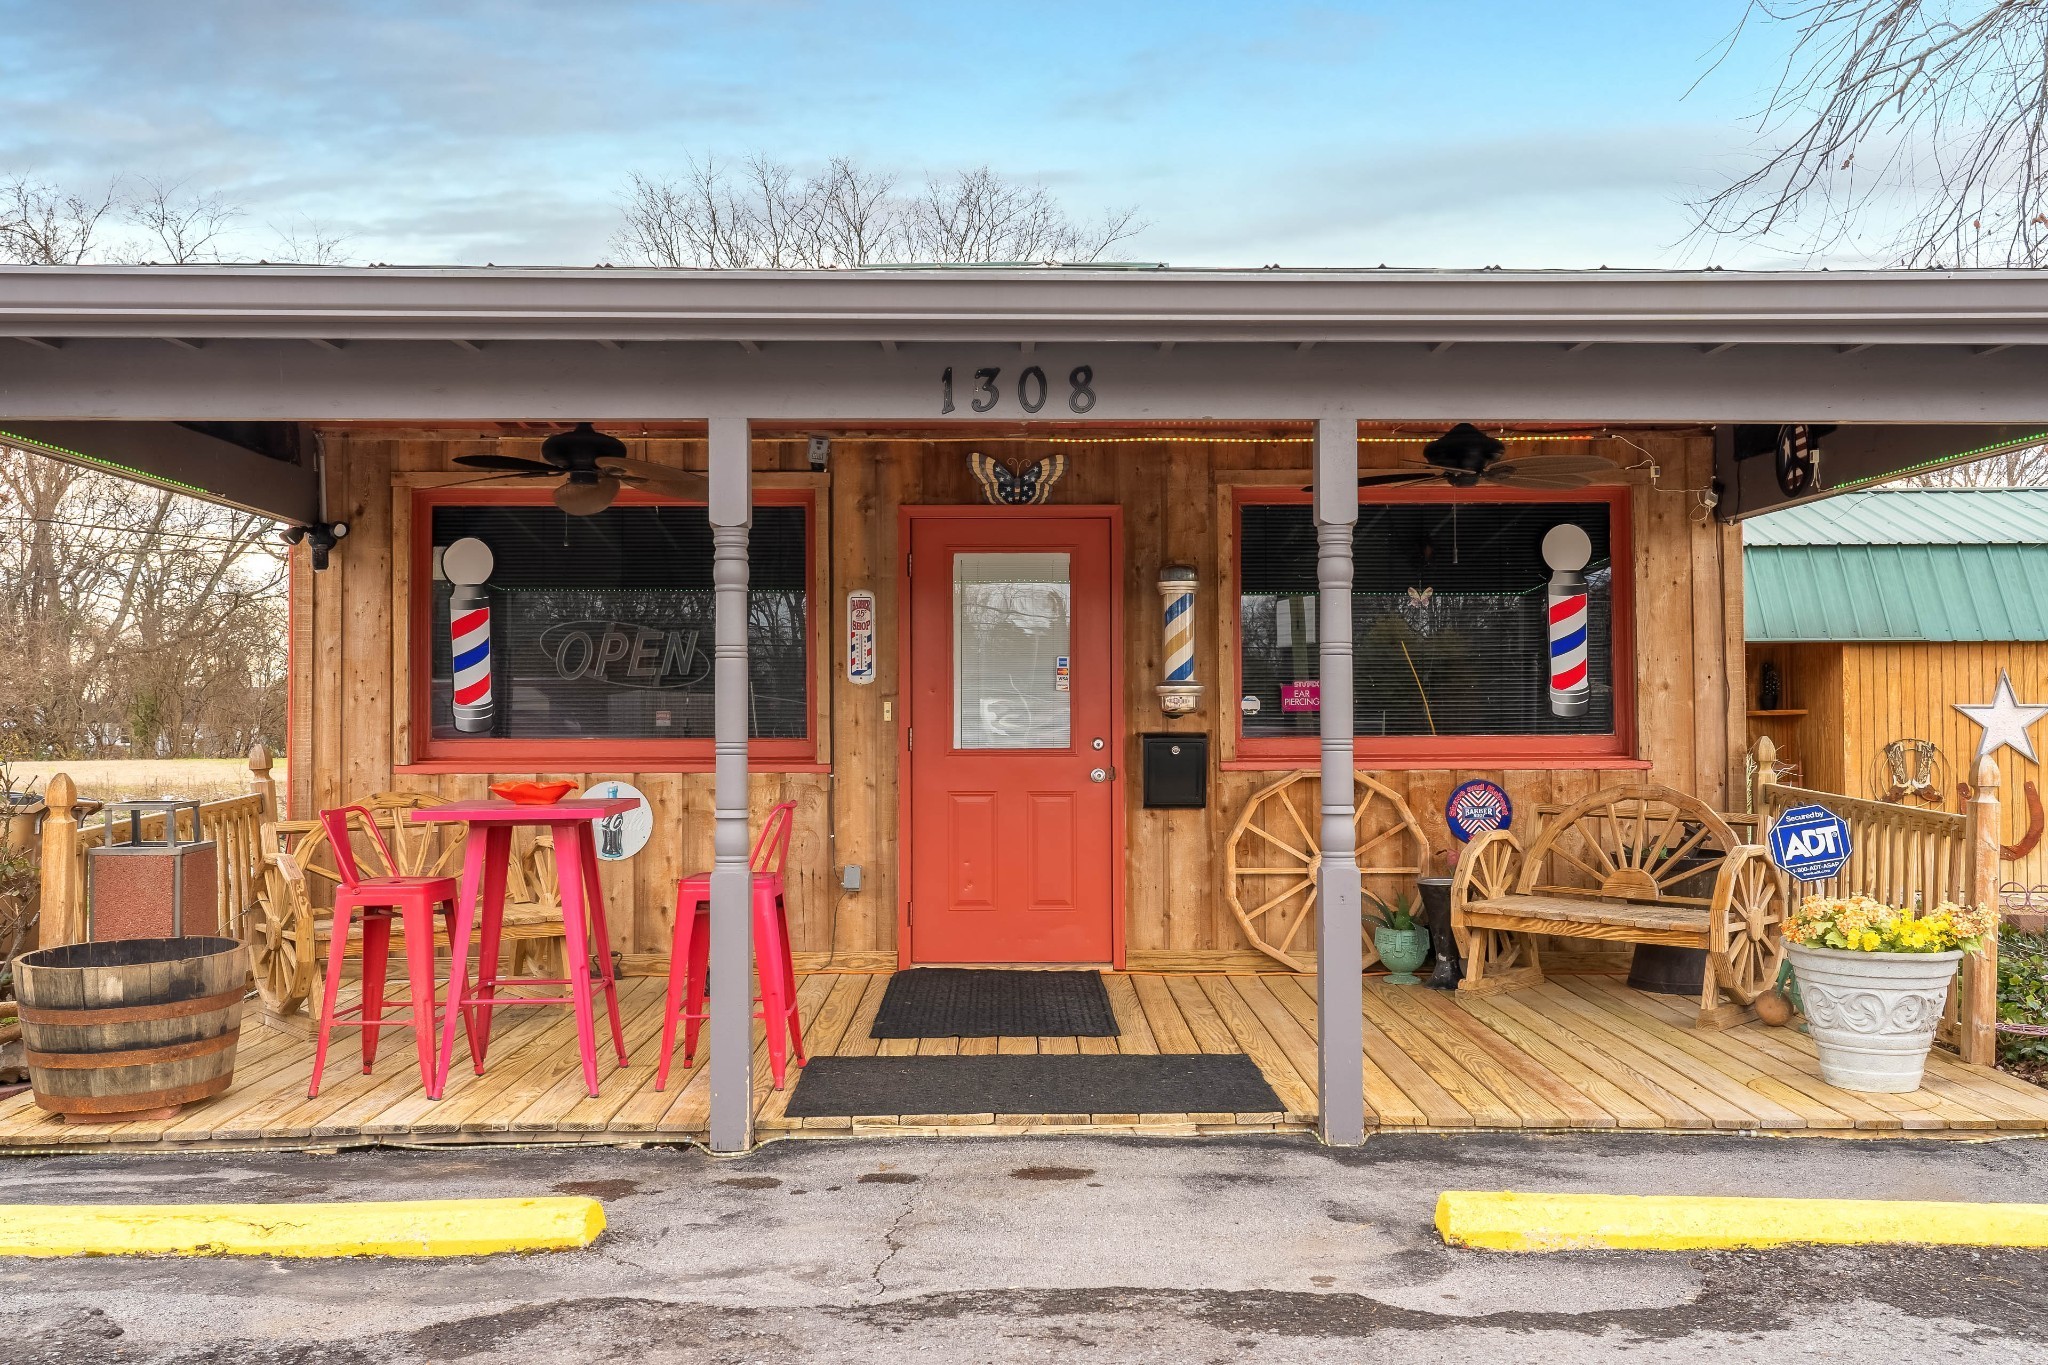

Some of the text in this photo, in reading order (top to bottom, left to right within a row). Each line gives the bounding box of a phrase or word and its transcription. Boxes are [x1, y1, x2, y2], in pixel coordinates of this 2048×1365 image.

[941, 365, 1097, 414] 1308
[852, 620, 871, 630] SHOP
[556, 631, 699, 681] OPEN
[1293, 690, 1310, 698] EAR
[1284, 698, 1320, 706] PIERCING
[1465, 807, 1493, 816] BARBER
[1785, 811, 1815, 822] Secured
